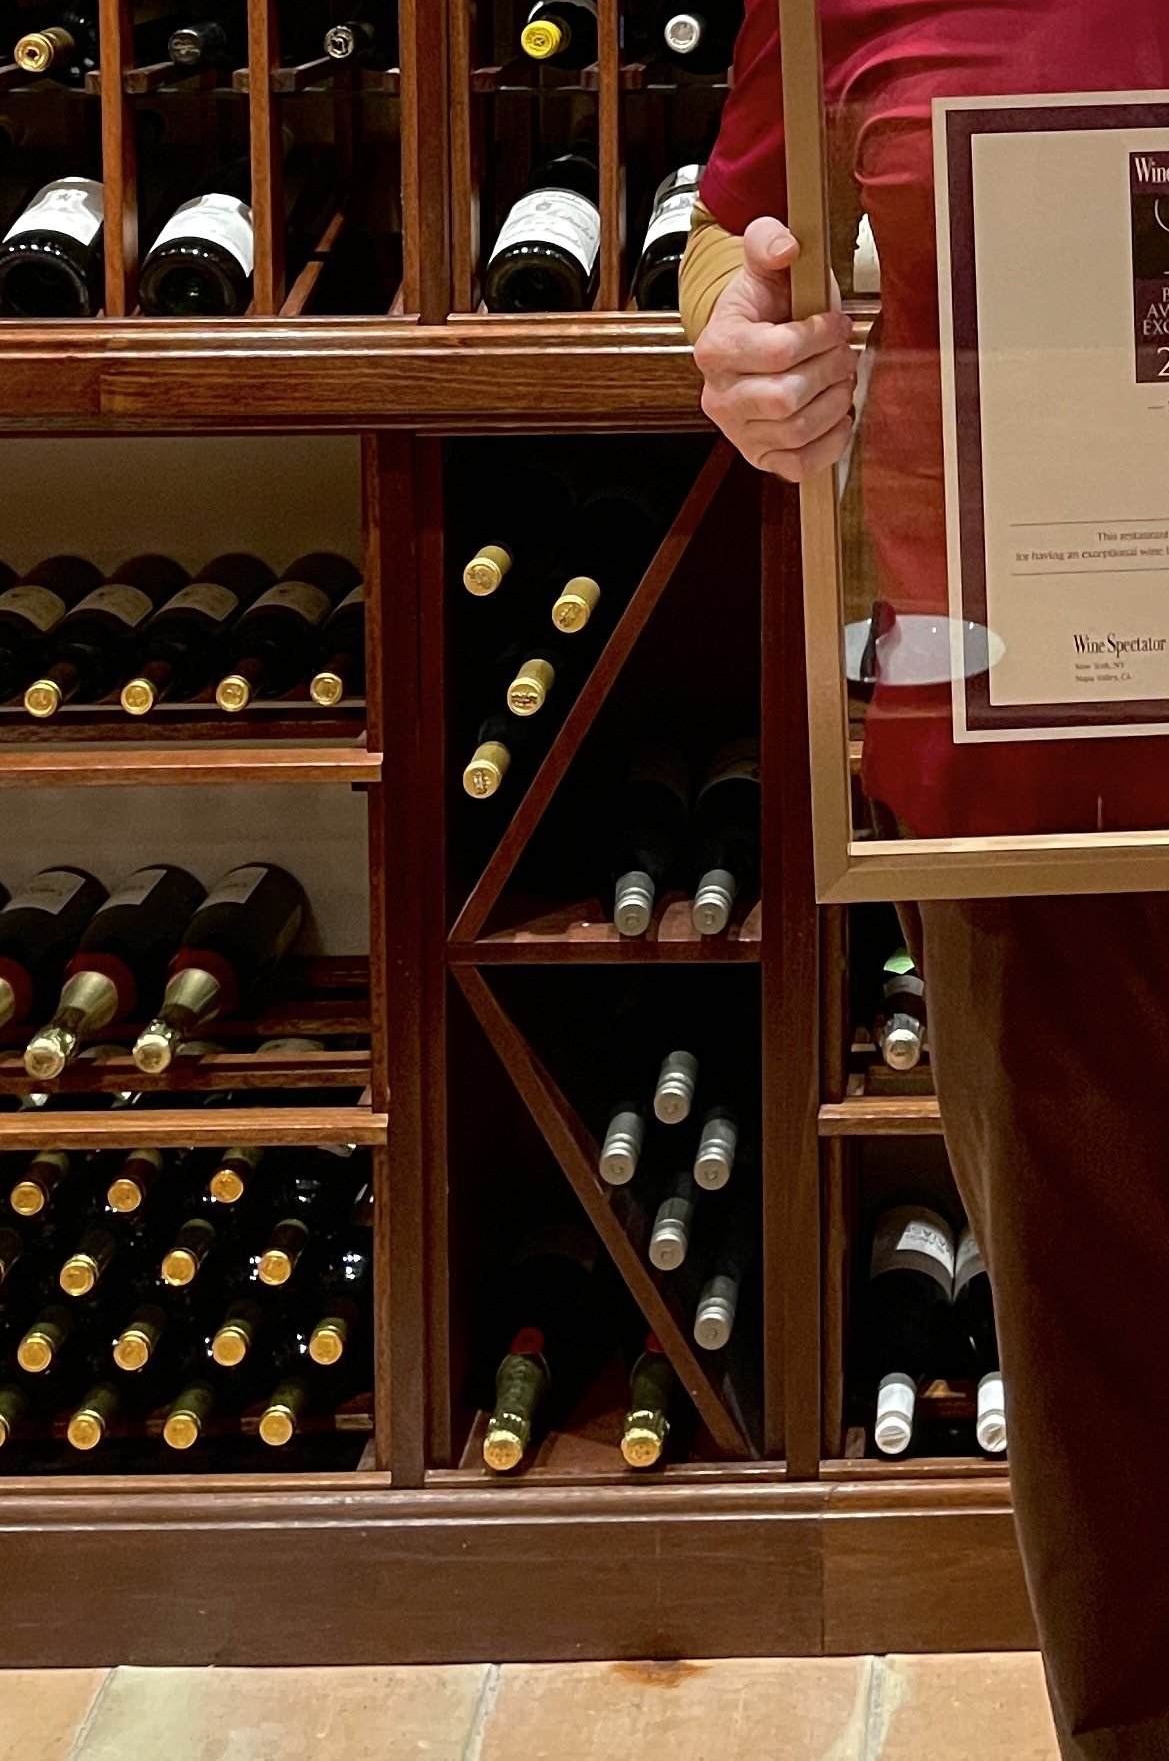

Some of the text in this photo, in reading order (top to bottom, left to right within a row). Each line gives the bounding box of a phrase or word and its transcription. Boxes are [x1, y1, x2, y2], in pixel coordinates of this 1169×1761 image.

[1097, 532, 1118, 541] This
[1120, 530, 1169, 540] restaurant
[1015, 552, 1029, 562] for
[1031, 551, 1065, 561] having
[1067, 551, 1079, 560] an
[1081, 548, 1138, 559] exceptional
[1139, 548, 1164, 557] wine
[1073, 632, 1167, 658] Wine Spectator
